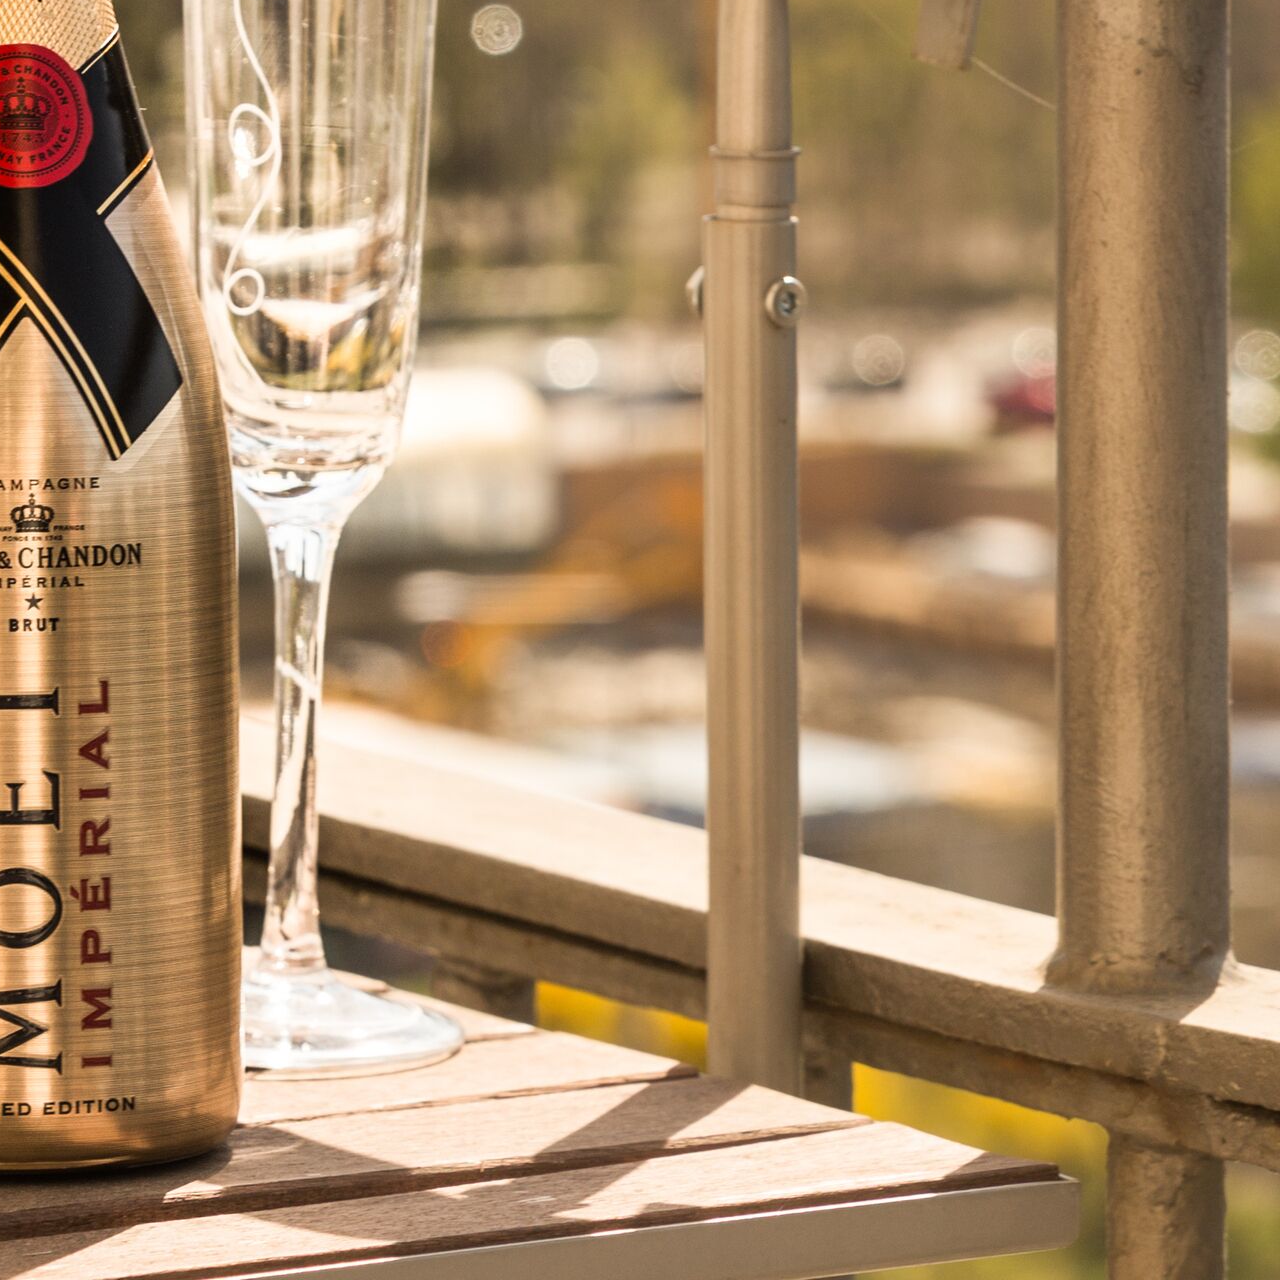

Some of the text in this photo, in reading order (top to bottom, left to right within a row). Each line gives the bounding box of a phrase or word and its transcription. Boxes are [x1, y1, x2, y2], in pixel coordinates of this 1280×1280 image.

[1, 67, 10, 76] &
[14, 64, 69, 105] CHANDON
[29, 127, 70, 164] FRANCE
[18, 543, 142, 569] CHANDON
[8, 618, 60, 632] BRUT
[70, 680, 113, 1068] IMPÉRIAL
[43, 1096, 136, 1116] EDITION
